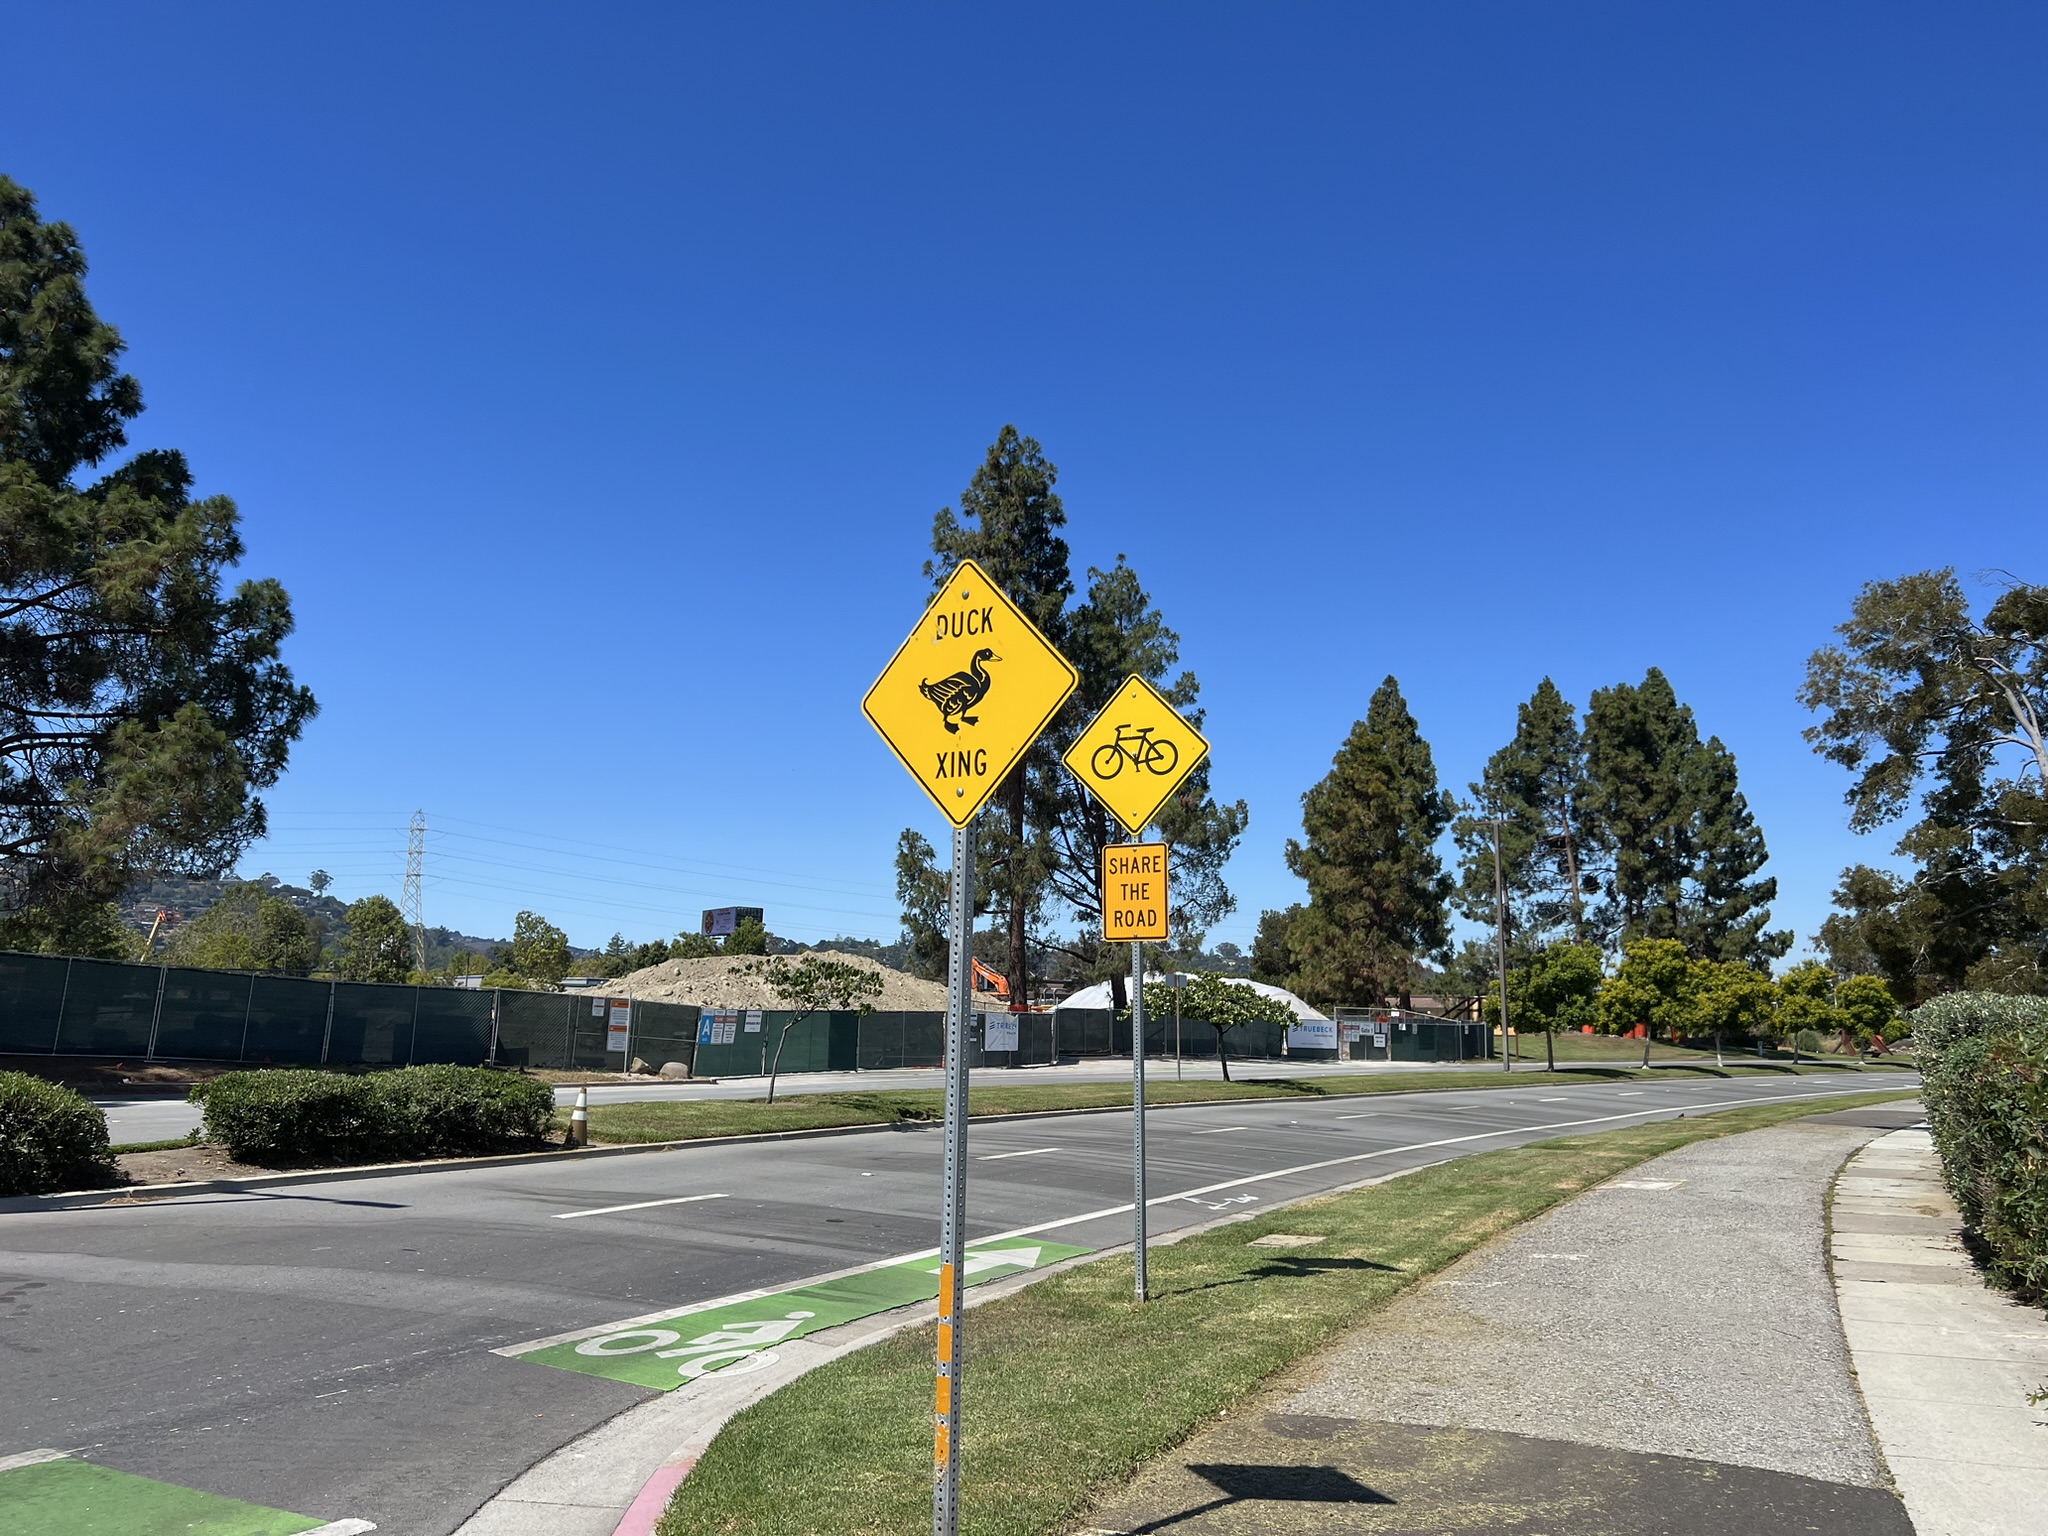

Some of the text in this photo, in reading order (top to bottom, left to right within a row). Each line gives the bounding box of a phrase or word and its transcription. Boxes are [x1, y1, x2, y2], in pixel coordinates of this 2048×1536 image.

[936, 606, 993, 640] DUCK
[935, 748, 987, 779] XING
[1109, 855, 1162, 875] SHARE
[1120, 882, 1150, 901] THE
[1114, 909, 1157, 928] ROAD
[701, 1018, 710, 1036] A
[1300, 1025, 1334, 1033] TRUEBECK
